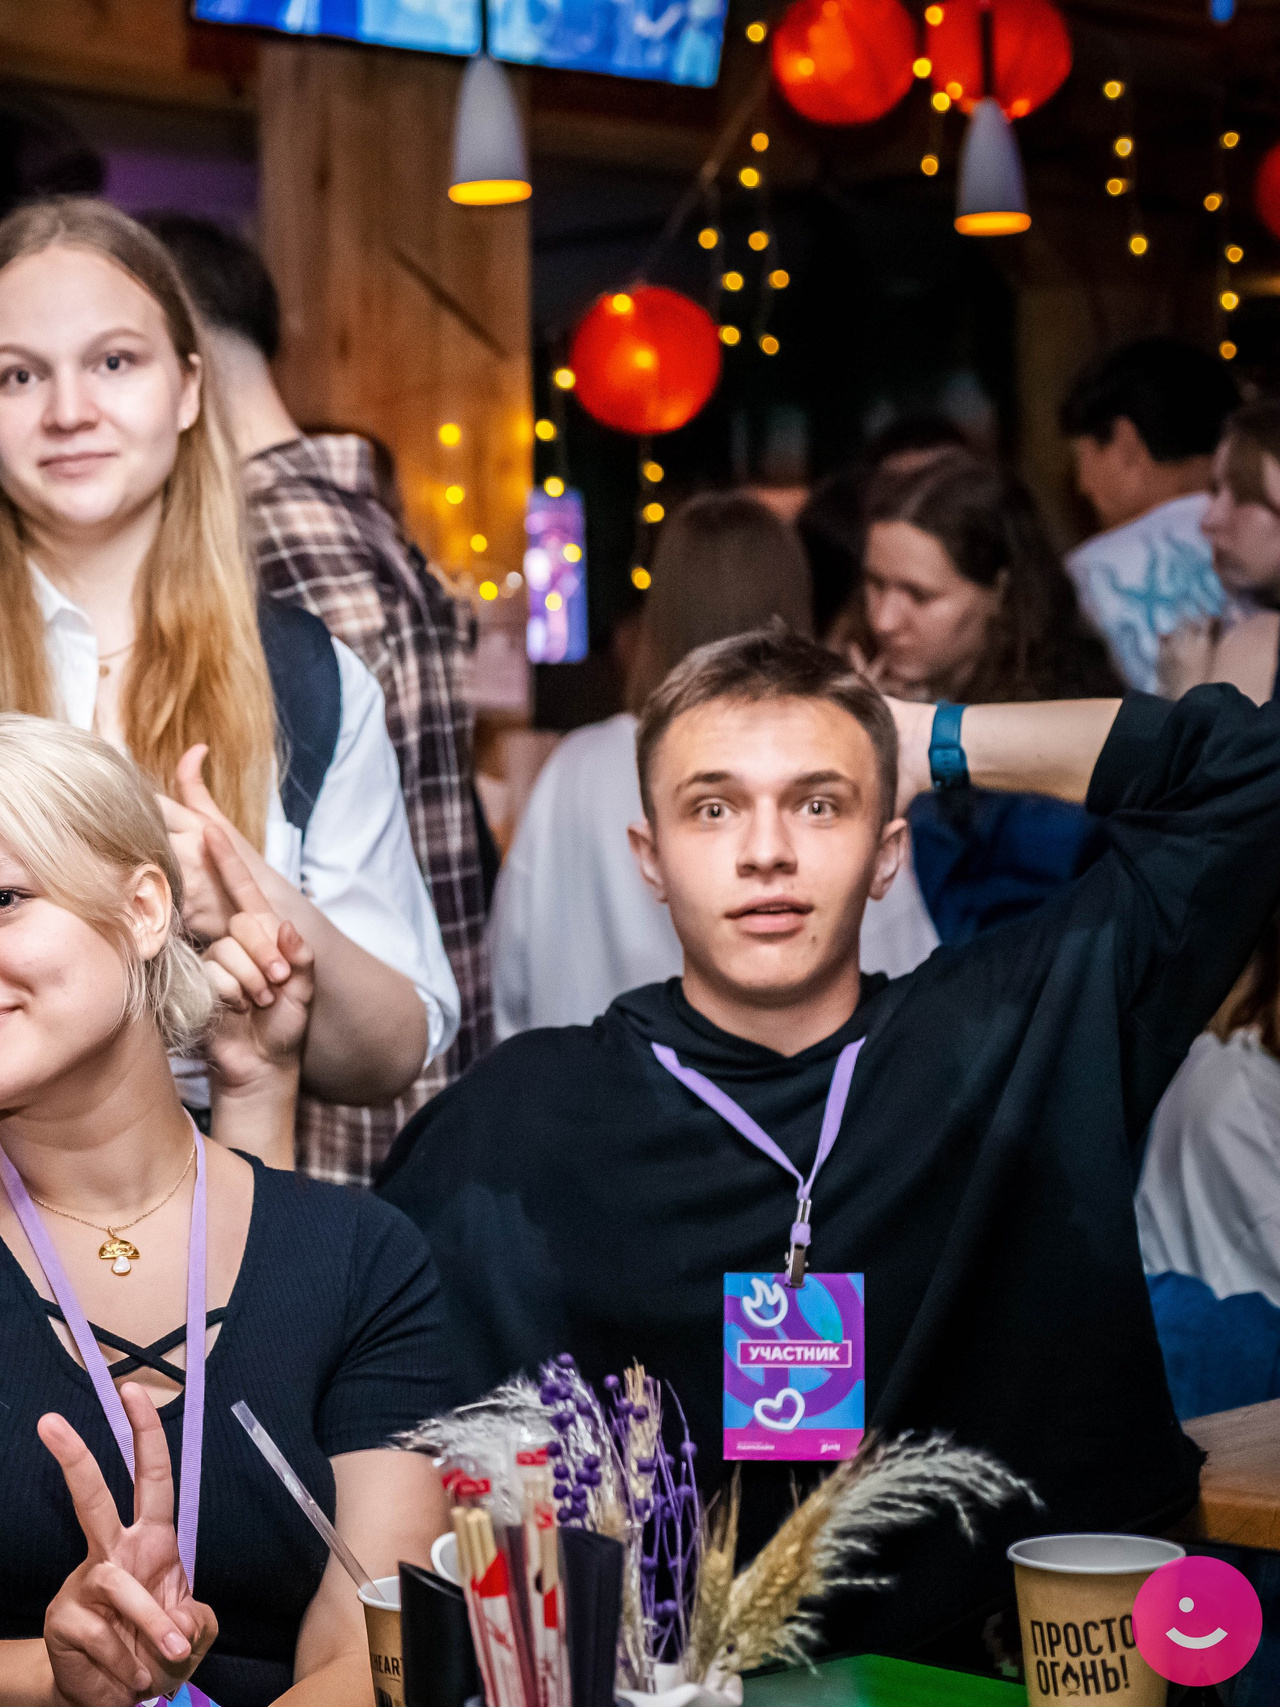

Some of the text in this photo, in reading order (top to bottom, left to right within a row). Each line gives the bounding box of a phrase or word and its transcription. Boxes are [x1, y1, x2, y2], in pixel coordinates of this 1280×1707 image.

[749, 1346, 840, 1361] УЧАСТНИК
[1030, 1614, 1137, 1658] ПРОСТО
[372, 1653, 403, 1676] HEAR
